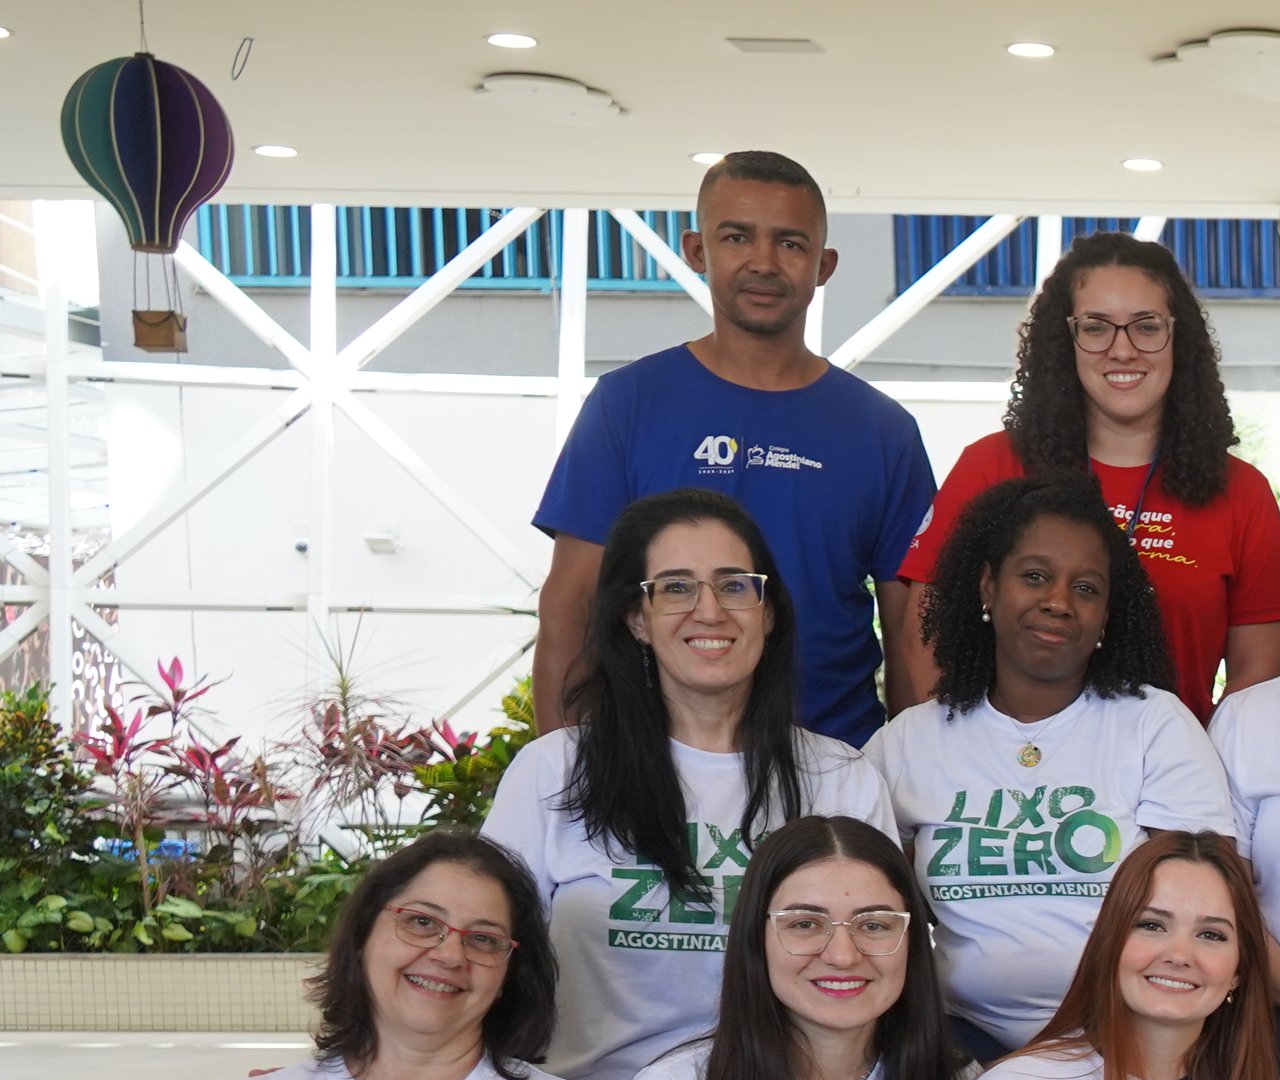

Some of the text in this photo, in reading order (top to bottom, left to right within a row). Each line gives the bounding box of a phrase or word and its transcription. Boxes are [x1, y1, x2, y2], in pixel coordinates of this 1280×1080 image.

[694, 435, 735, 466] 40
[765, 459, 800, 470] Mendel
[766, 451, 822, 469] Agostiniano
[1140, 511, 1172, 523] que
[1141, 537, 1174, 549] que
[944, 785, 1096, 830] LIXO
[927, 809, 1122, 877] ZERO
[933, 882, 1108, 900] AGOSTINIANO MENDE
[614, 931, 727, 951] AGOSTINIA
